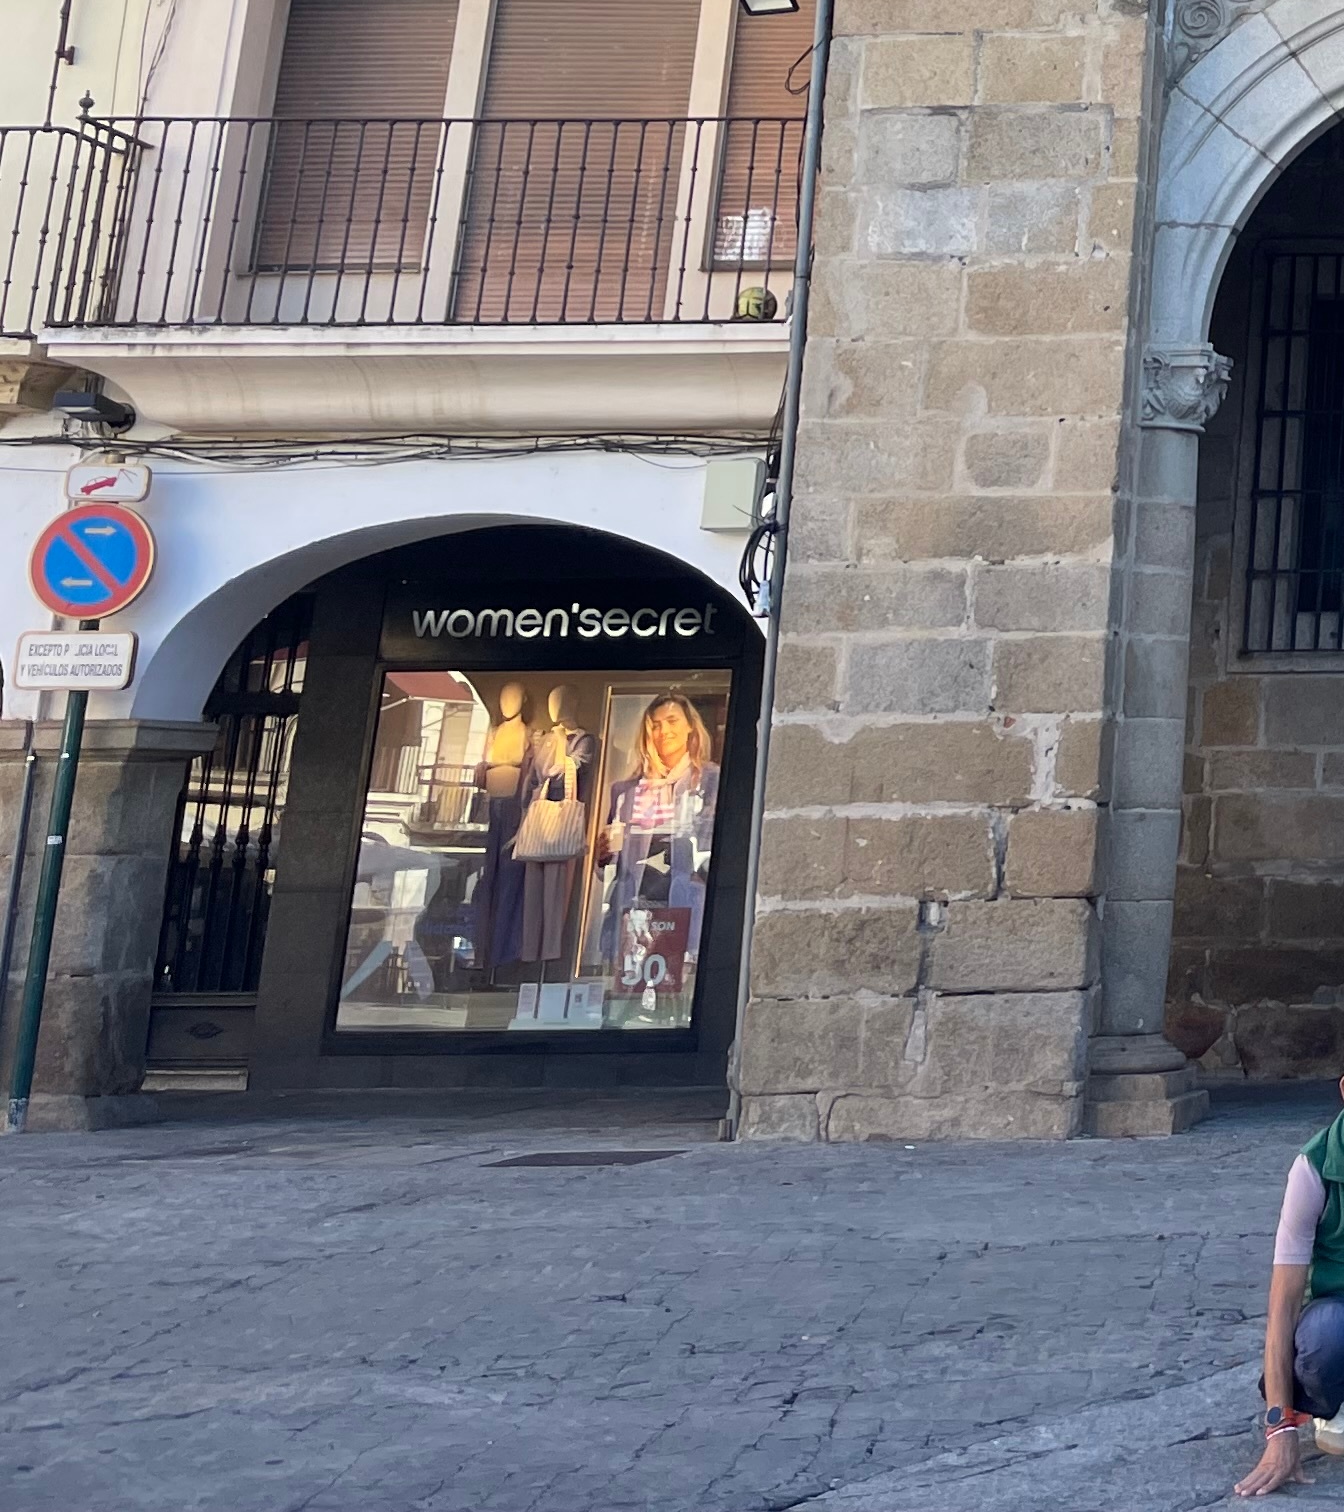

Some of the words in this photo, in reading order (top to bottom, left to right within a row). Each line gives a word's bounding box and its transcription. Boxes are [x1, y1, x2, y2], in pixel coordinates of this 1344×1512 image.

[412, 602, 717, 637] women'secret
[28, 643, 63, 656] EXCEPTO
[20, 664, 25, 676] Y
[70, 663, 123, 677] AUTORIZADOS
